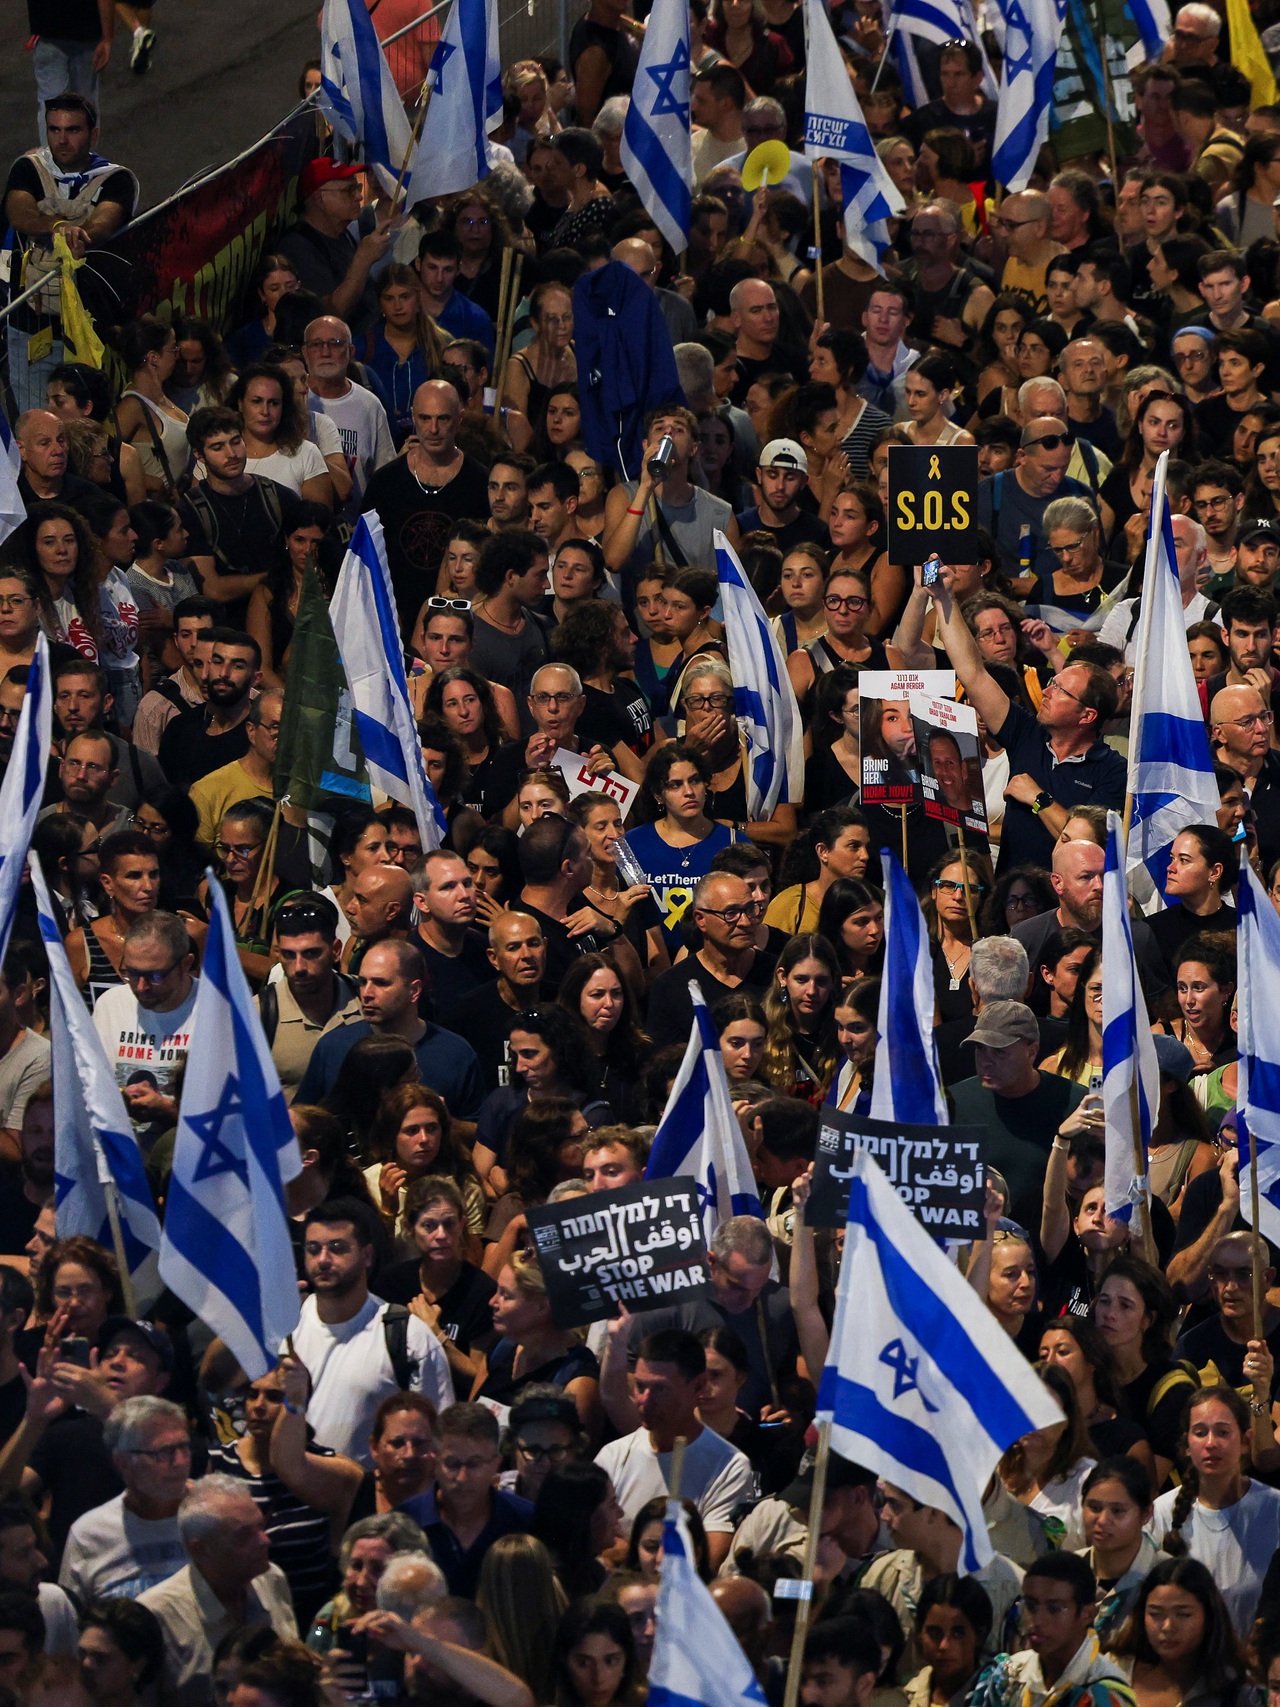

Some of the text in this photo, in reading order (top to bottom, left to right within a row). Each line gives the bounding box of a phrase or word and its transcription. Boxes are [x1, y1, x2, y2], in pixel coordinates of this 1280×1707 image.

[897, 490, 970, 531] S.O.S
[863, 758, 889, 772] BRING
[863, 772, 880, 785] HER
[920, 773, 940, 791] BRING
[863, 784, 914, 798] HOME NOW!
[922, 786, 936, 801] HIM
[119, 1031, 190, 1047] BRING ITAY
[118, 1045, 154, 1061] HOME
[844, 1131, 950, 1184] למלחמה
[954, 1142, 980, 1160] די
[914, 1163, 983, 1194] أوقف
[664, 1193, 691, 1213] די
[560, 1195, 660, 1257] למלחמה
[919, 1206, 980, 1227] WAR
[633, 1213, 701, 1251] أوقف
[595, 1255, 655, 1285] STOP
[603, 1281, 649, 1303] THE
[647, 1264, 707, 1295] WAR
